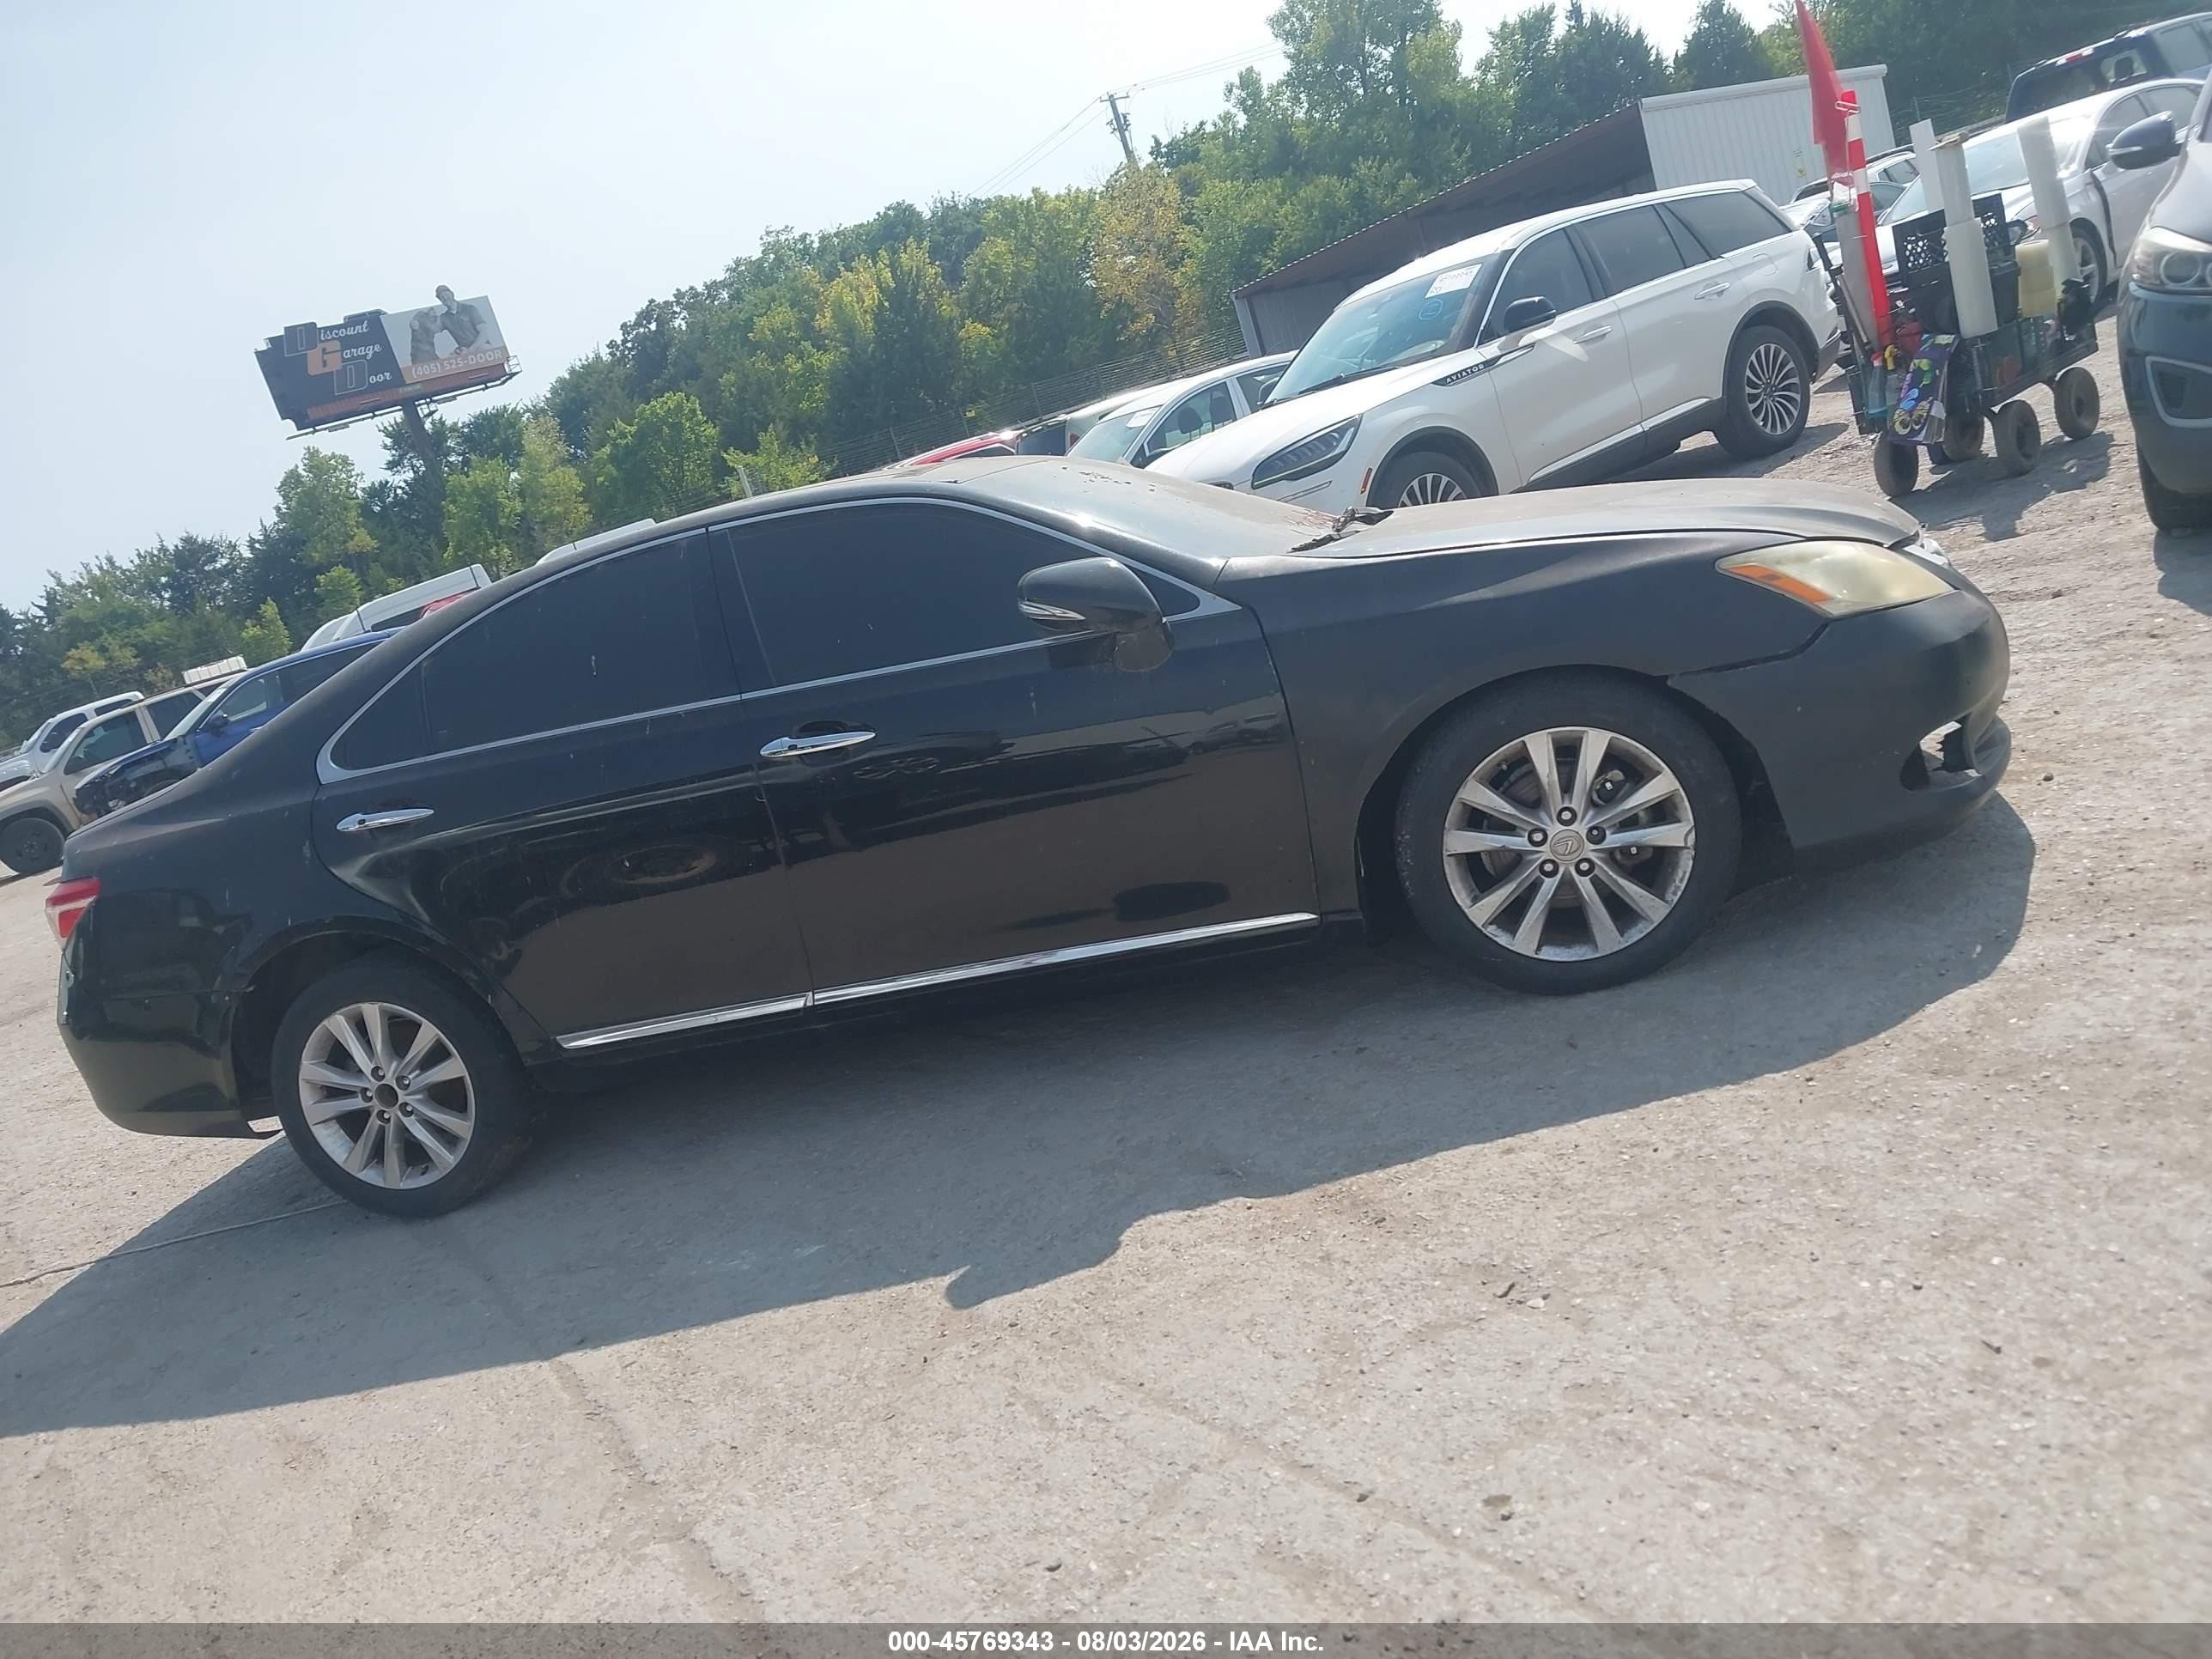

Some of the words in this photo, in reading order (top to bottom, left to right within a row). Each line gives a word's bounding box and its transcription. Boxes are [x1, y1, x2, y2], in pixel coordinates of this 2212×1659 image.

[412, 362, 441, 378] (405)
[444, 349, 502, 370] 525-DOOR
[1446, 363, 1485, 384] AVIATOR
